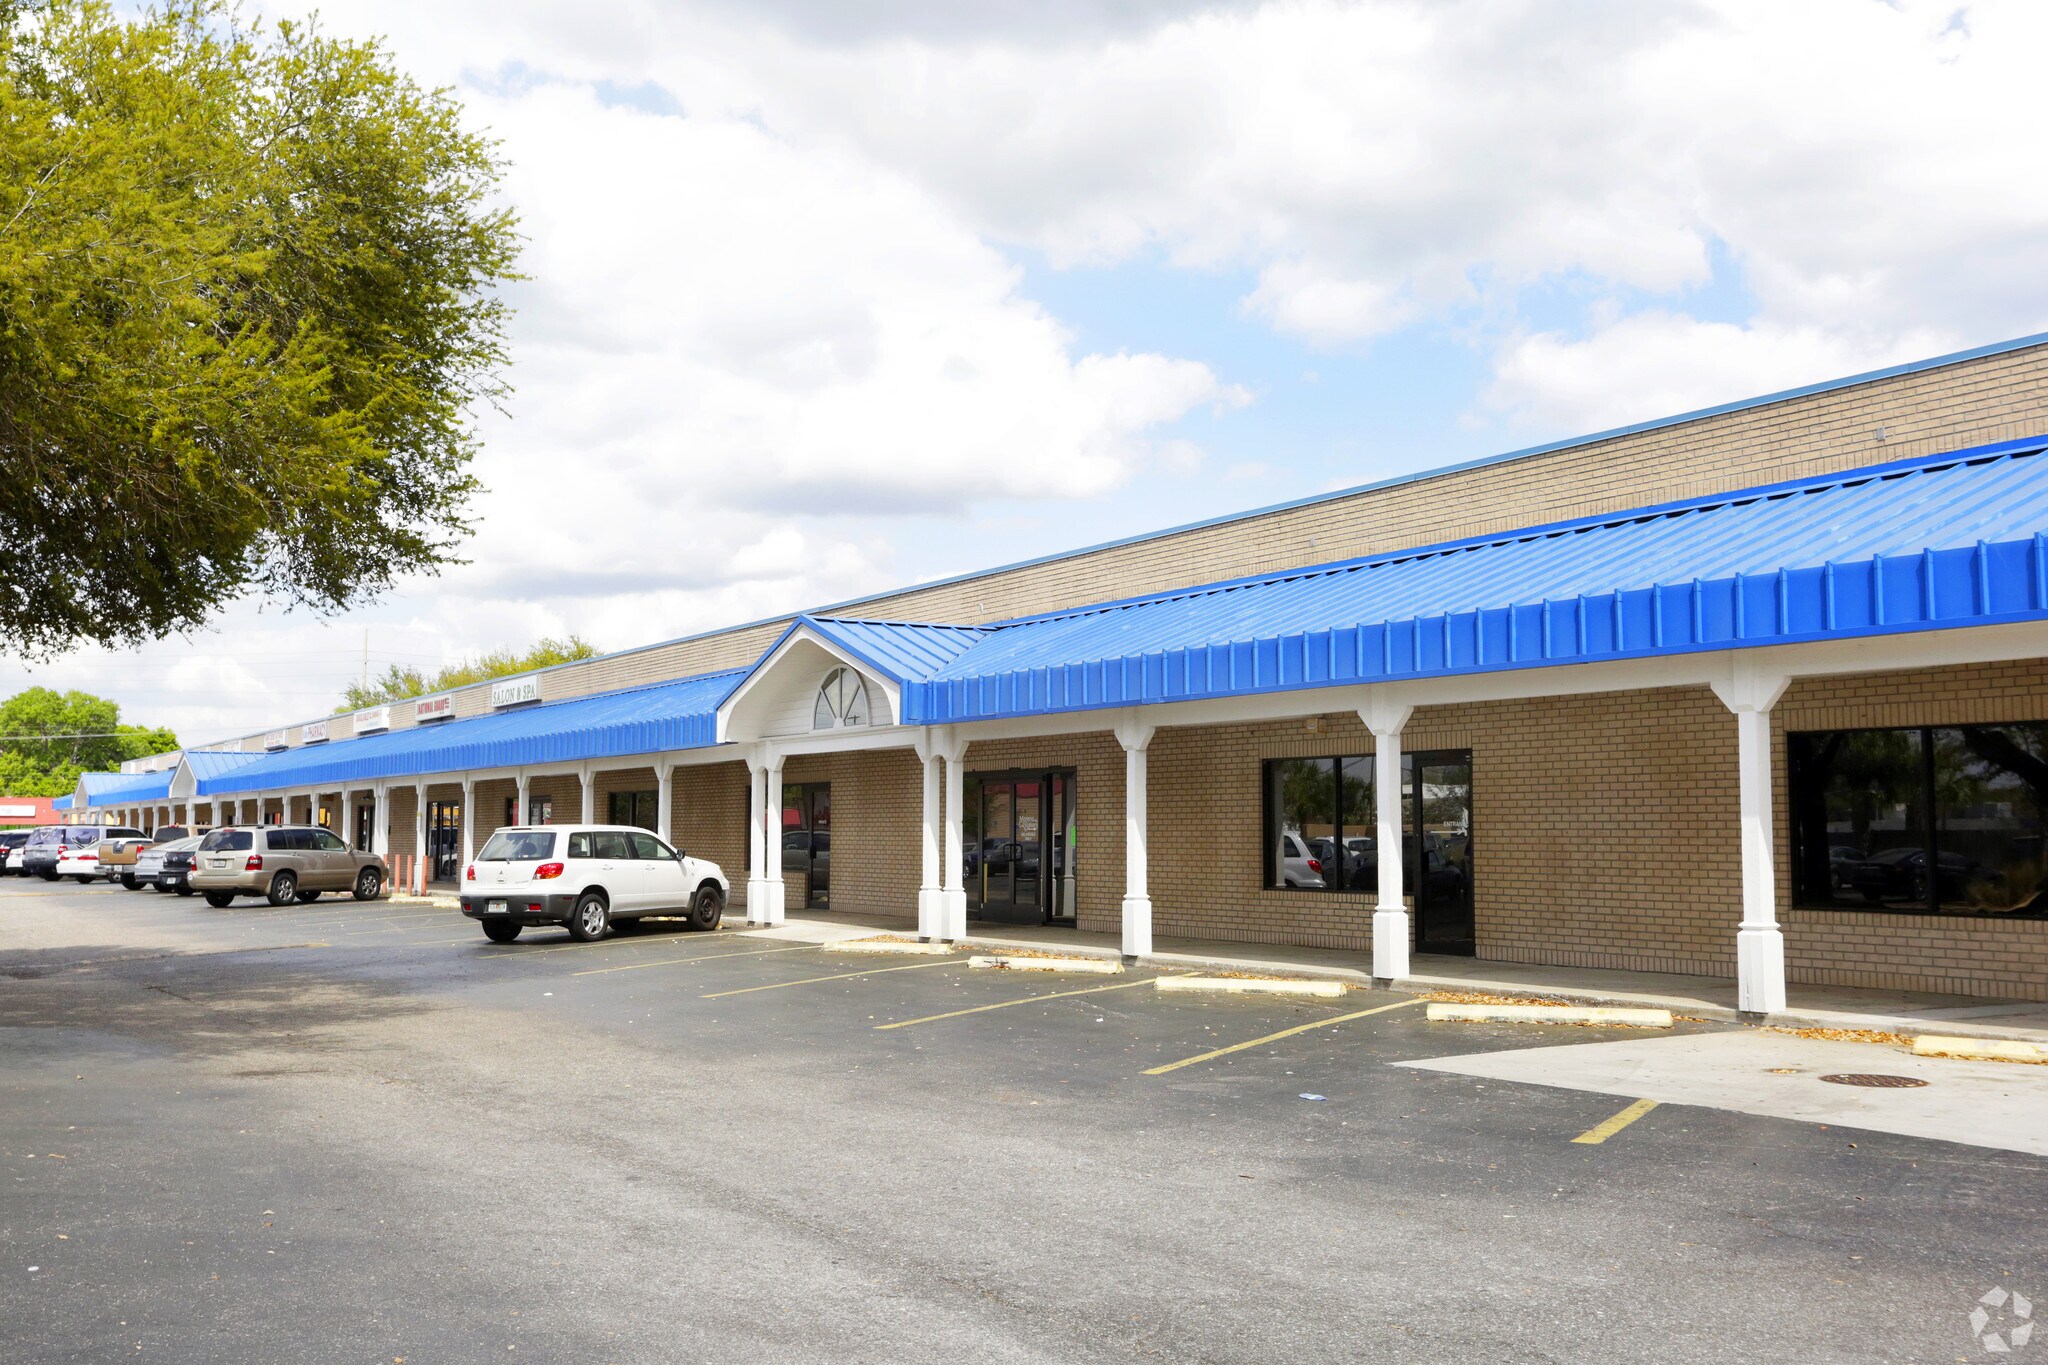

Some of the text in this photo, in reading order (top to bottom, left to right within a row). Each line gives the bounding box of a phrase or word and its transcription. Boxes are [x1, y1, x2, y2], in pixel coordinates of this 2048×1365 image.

[493, 684, 536, 705] SALON & SPA
[308, 723, 326, 737] PHARMACY
